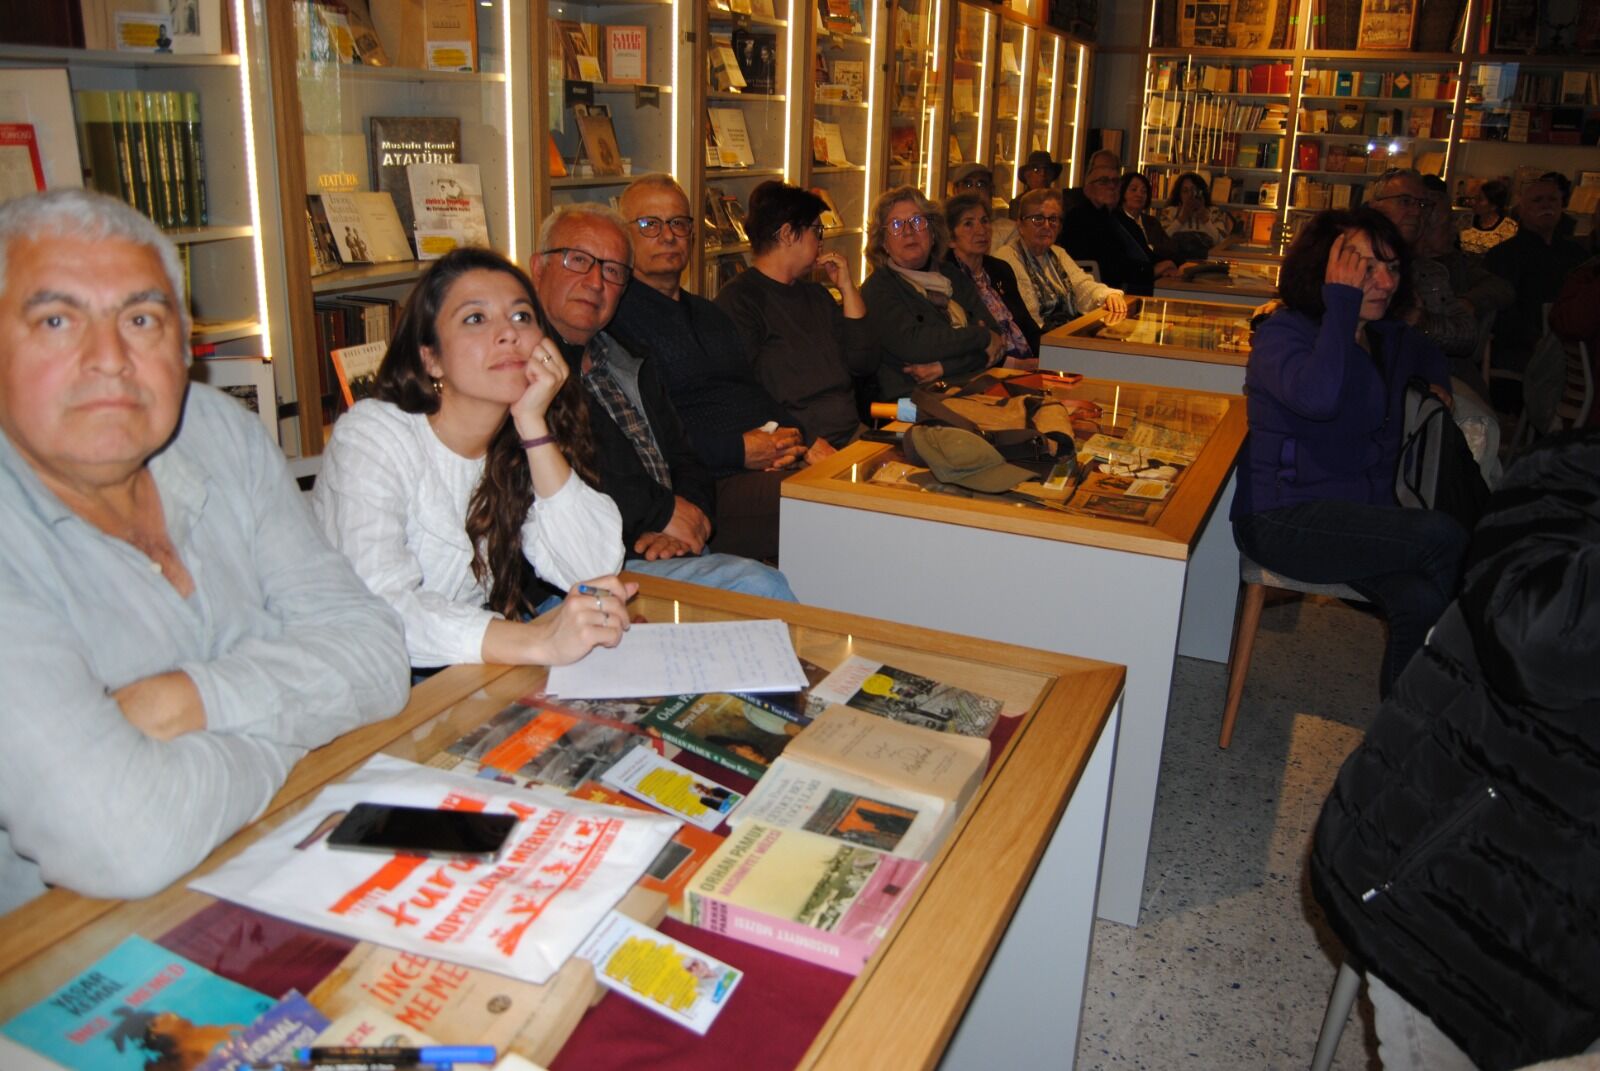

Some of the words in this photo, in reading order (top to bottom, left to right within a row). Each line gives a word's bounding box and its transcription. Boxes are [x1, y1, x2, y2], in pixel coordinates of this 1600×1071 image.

[382, 141, 422, 150] Mustafa
[424, 141, 455, 150] Kemal
[382, 151, 455, 167] ATATÜRK
[317, 171, 359, 187] ATATÜRK
[656, 699, 684, 721] Orhan
[700, 859, 737, 892] ORHAN
[735, 825, 767, 858] PAMUK
[395, 961, 470, 1032] MEME
